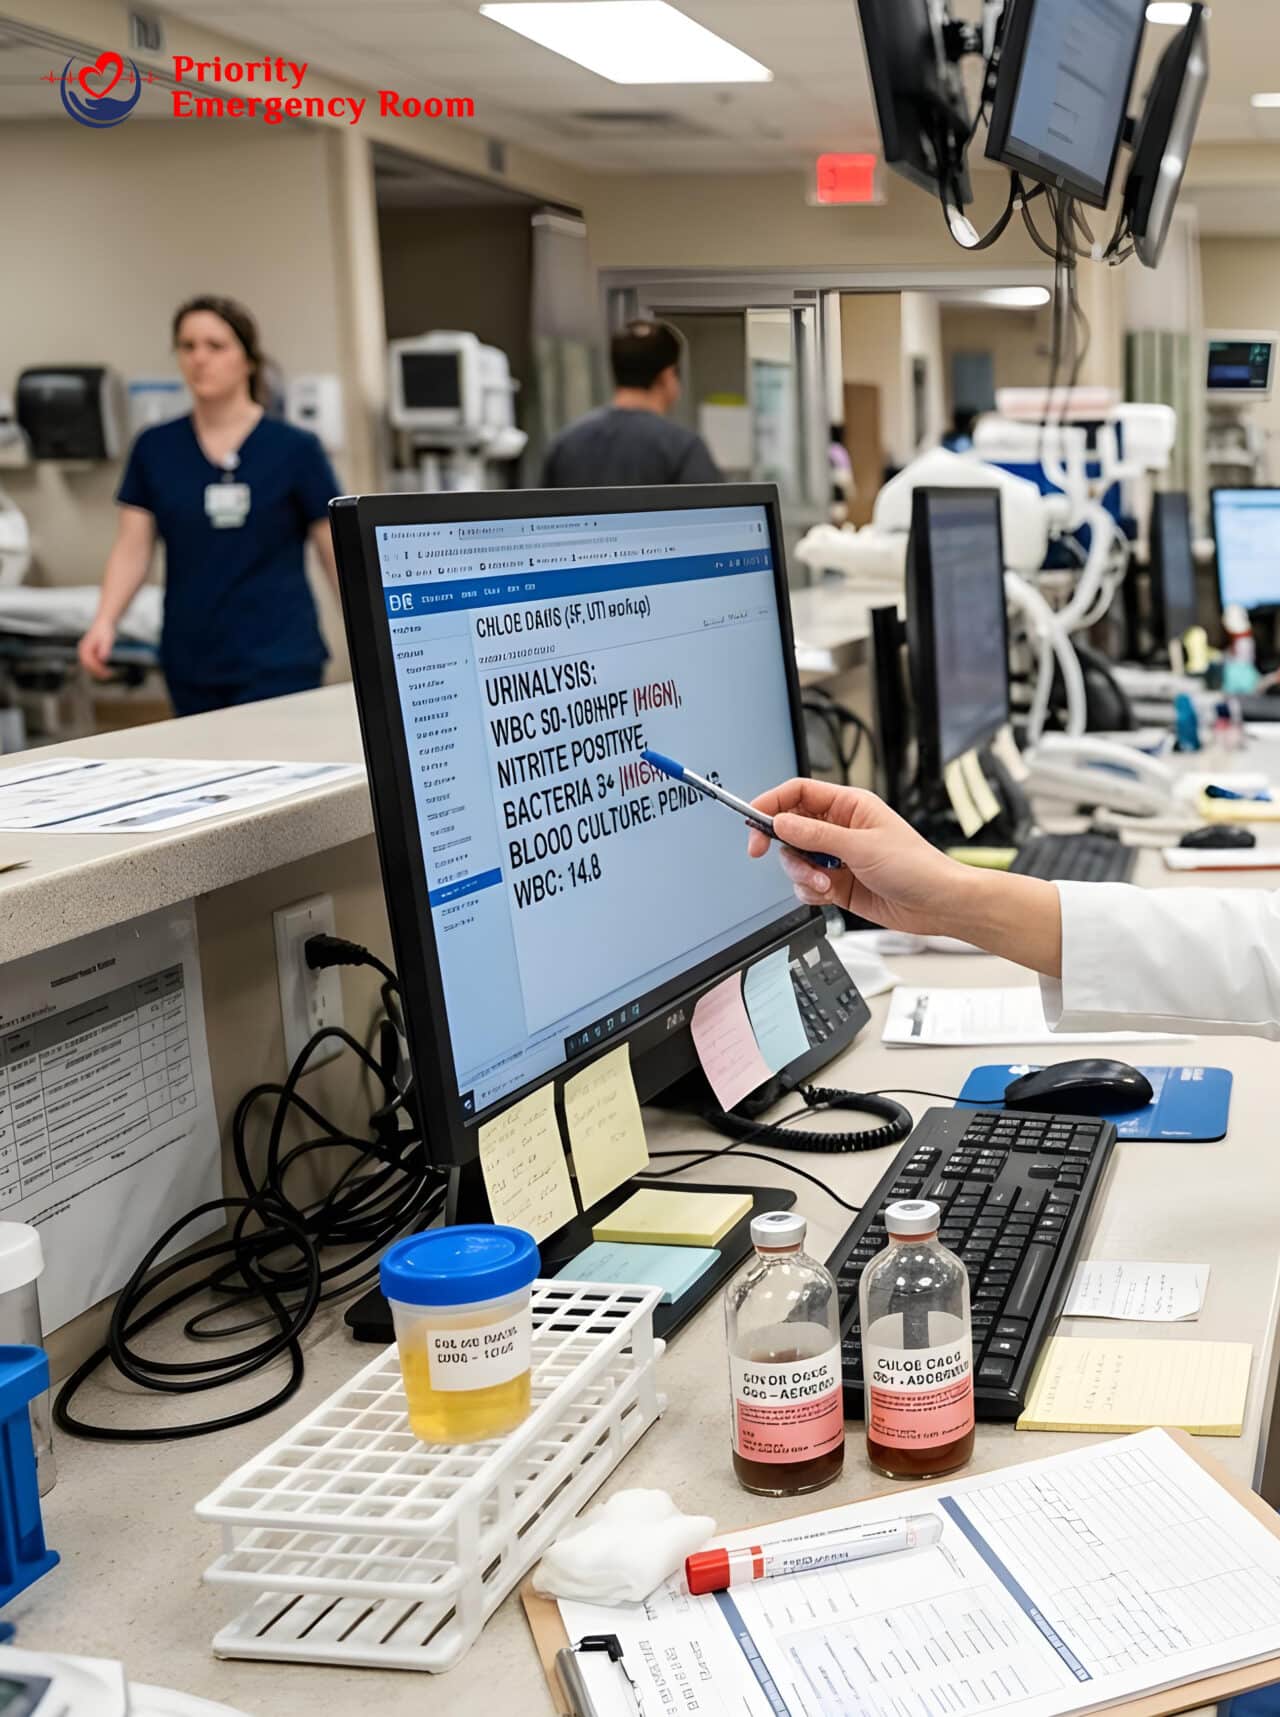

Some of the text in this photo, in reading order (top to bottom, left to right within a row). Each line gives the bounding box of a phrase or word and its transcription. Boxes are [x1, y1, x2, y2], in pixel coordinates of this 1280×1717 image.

[476, 610, 523, 639] CHLOE
[485, 660, 598, 706] URINALYSIS:
[490, 712, 537, 748] WBC
[497, 744, 570, 789] NITRITE
[503, 777, 594, 830] BACTERIA
[514, 869, 564, 909] WBC:
[568, 853, 602, 888] 14.8
